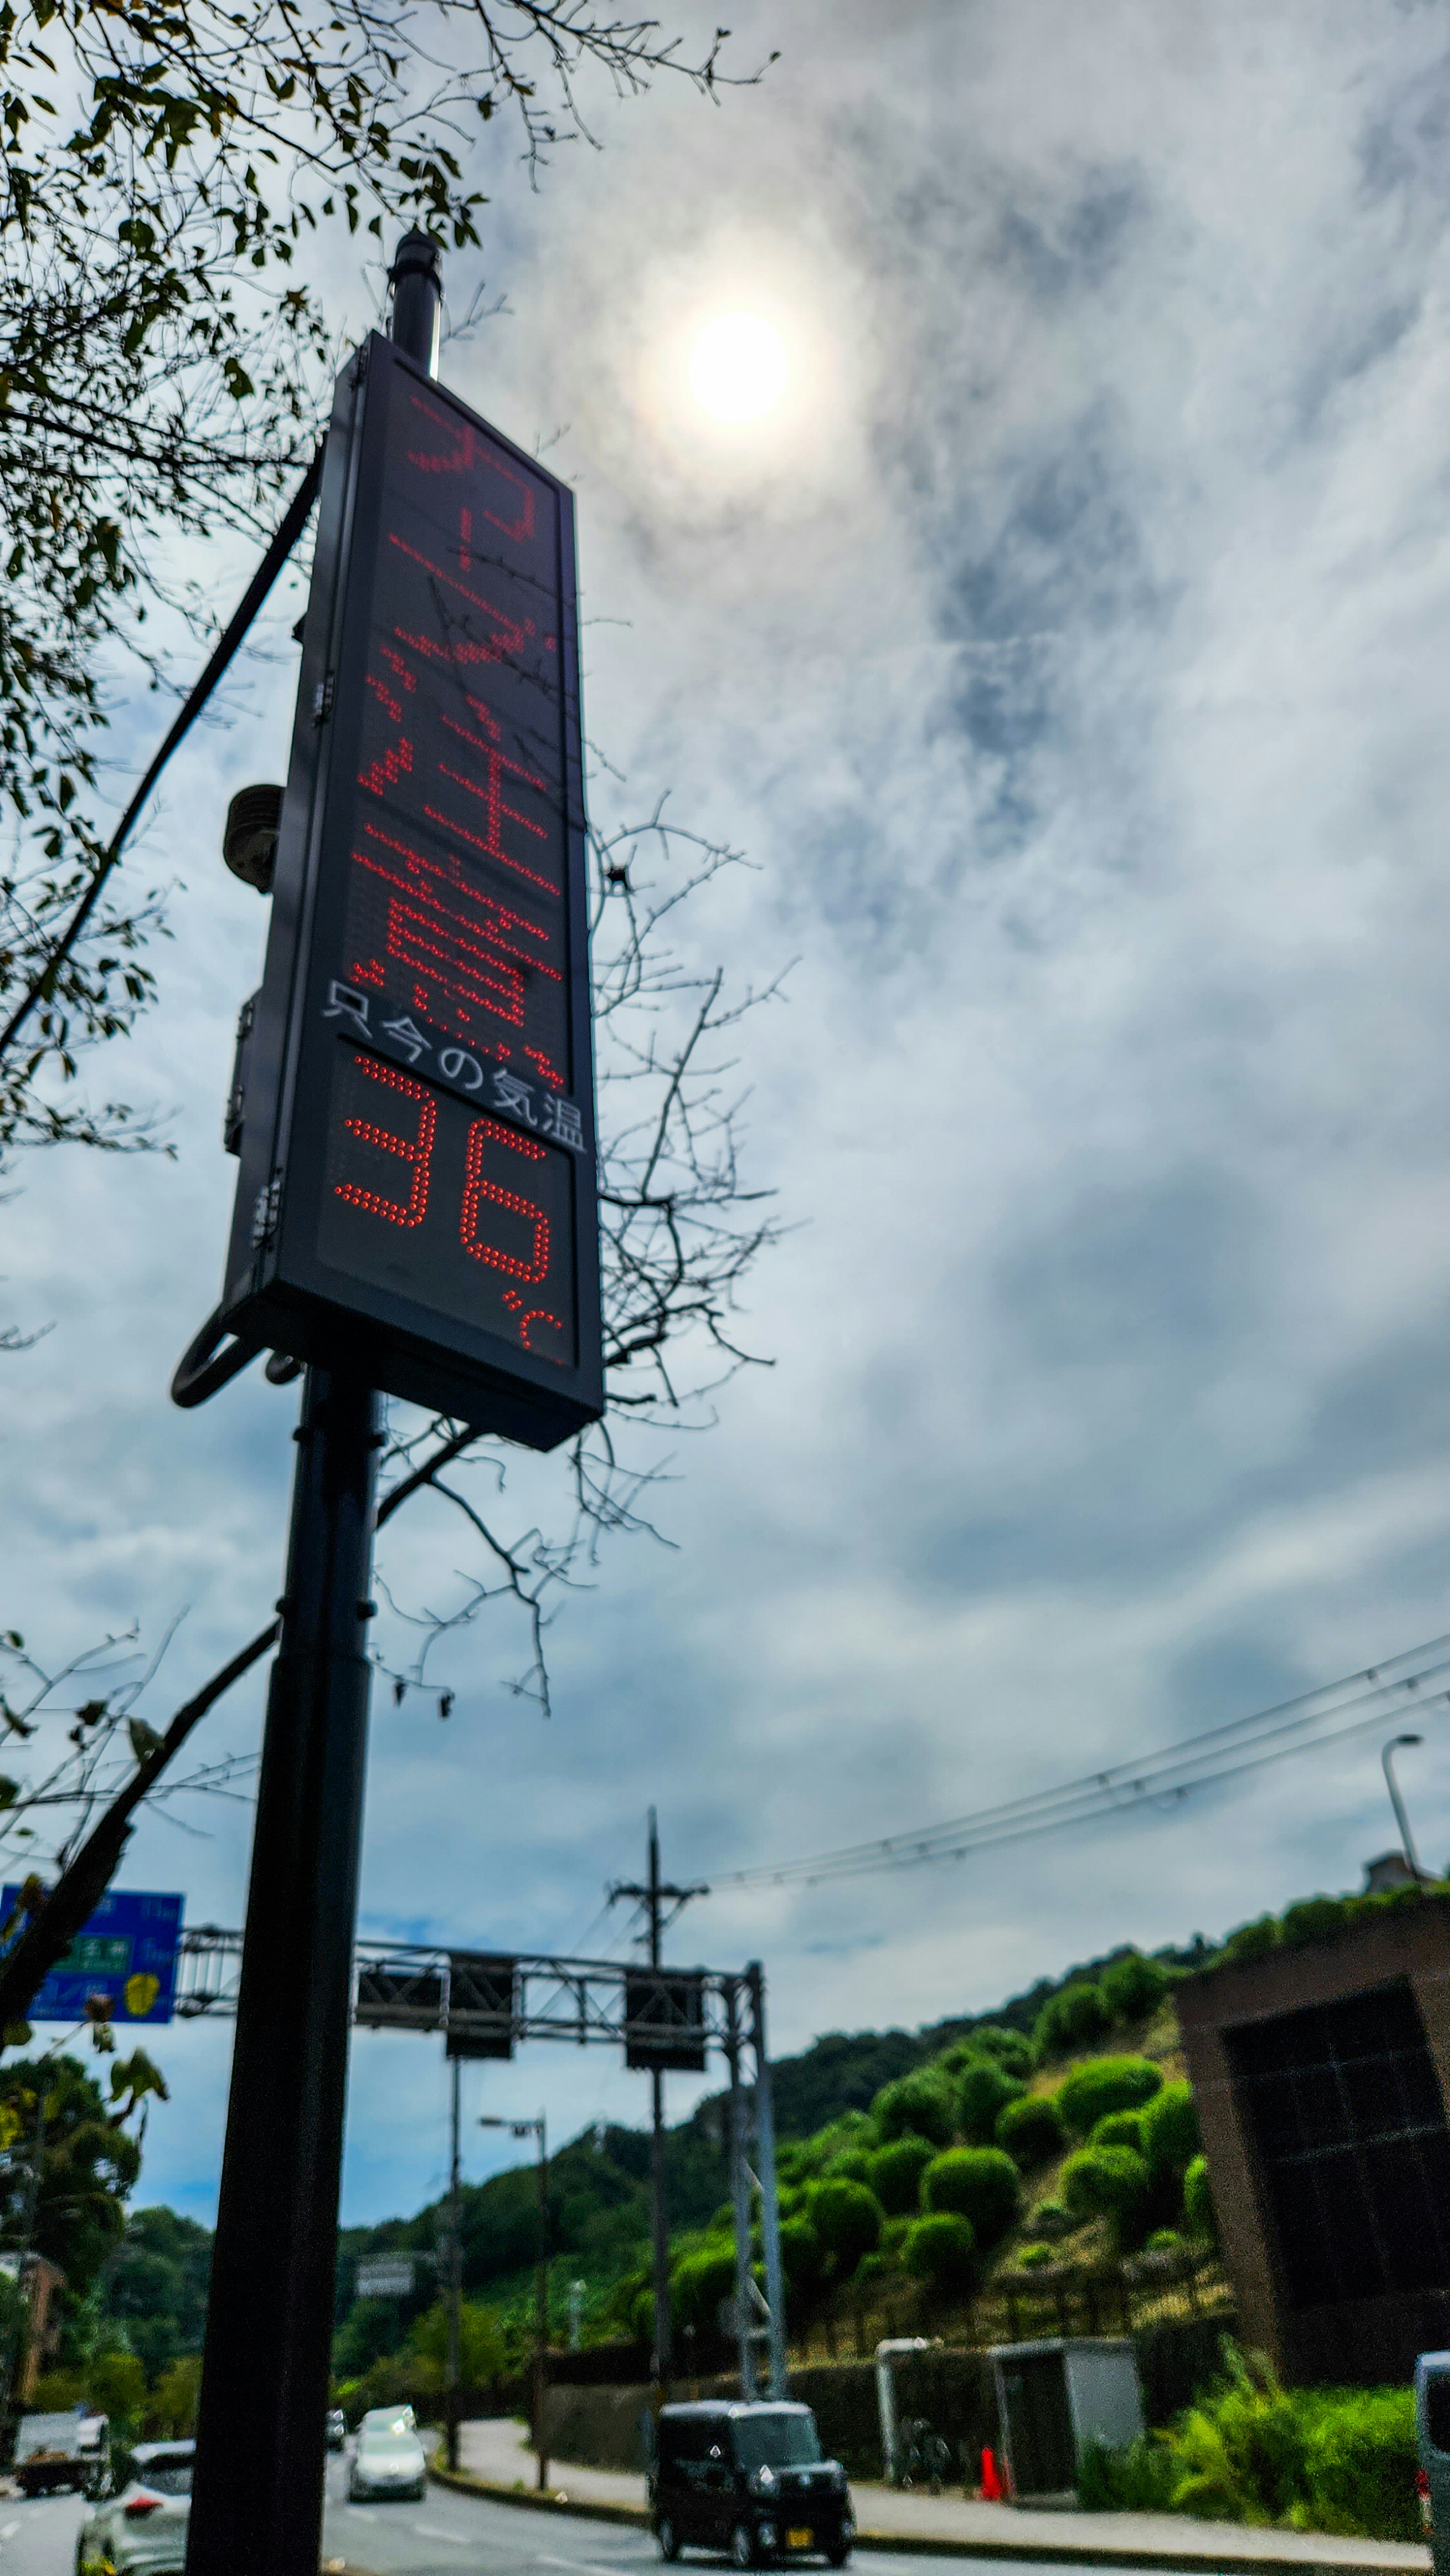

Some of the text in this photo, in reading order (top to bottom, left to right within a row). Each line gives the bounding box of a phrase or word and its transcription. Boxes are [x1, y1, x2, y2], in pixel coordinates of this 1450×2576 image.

[352, 396, 564, 1088] カーブ注意
[321, 979, 587, 1153] 只今の気温
